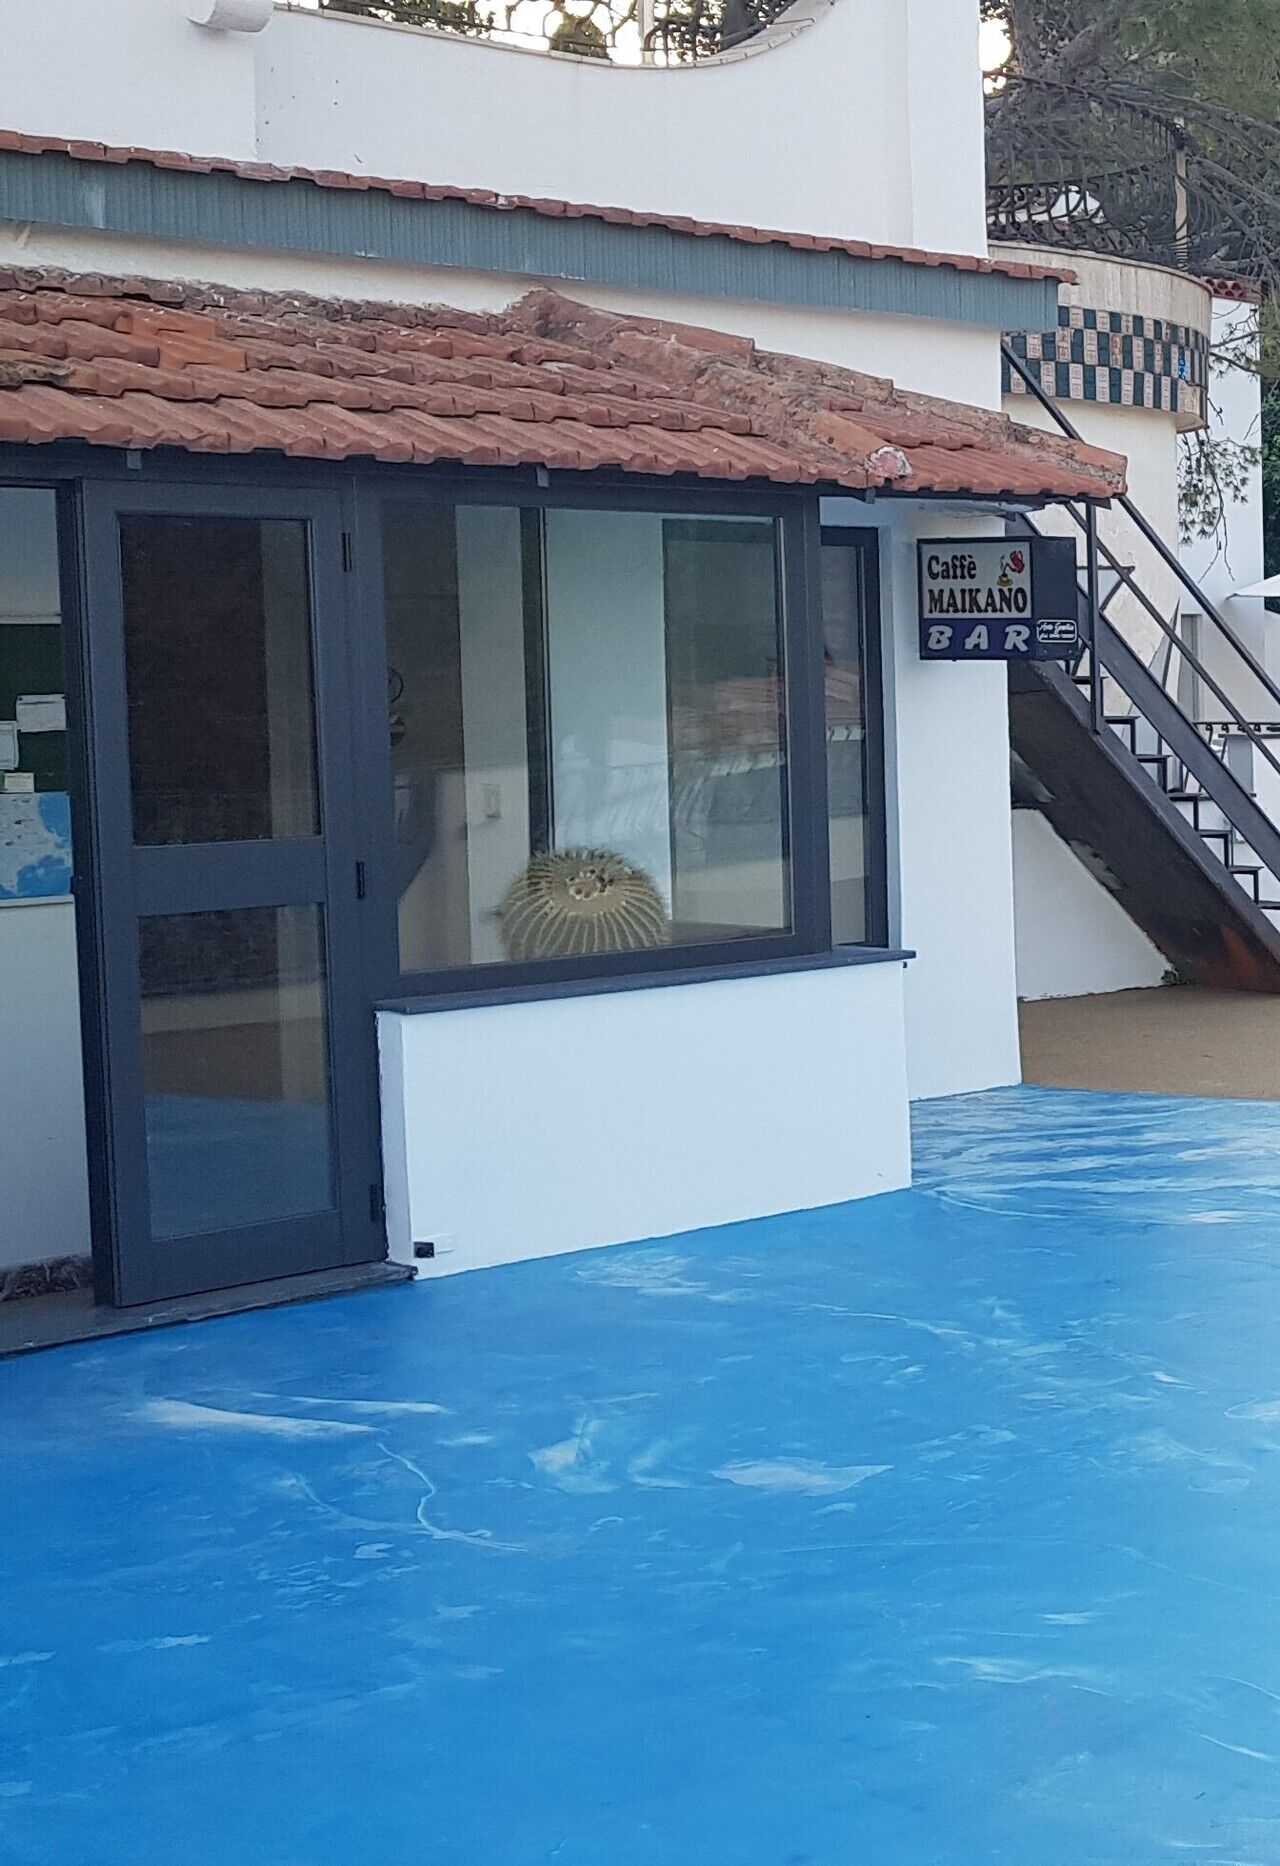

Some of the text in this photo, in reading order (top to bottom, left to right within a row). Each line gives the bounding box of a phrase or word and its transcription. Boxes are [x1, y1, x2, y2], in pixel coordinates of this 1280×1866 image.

[927, 554, 977, 581] Caffè
[928, 586, 1028, 614] MAIKANO
[927, 624, 1031, 652] BAR
